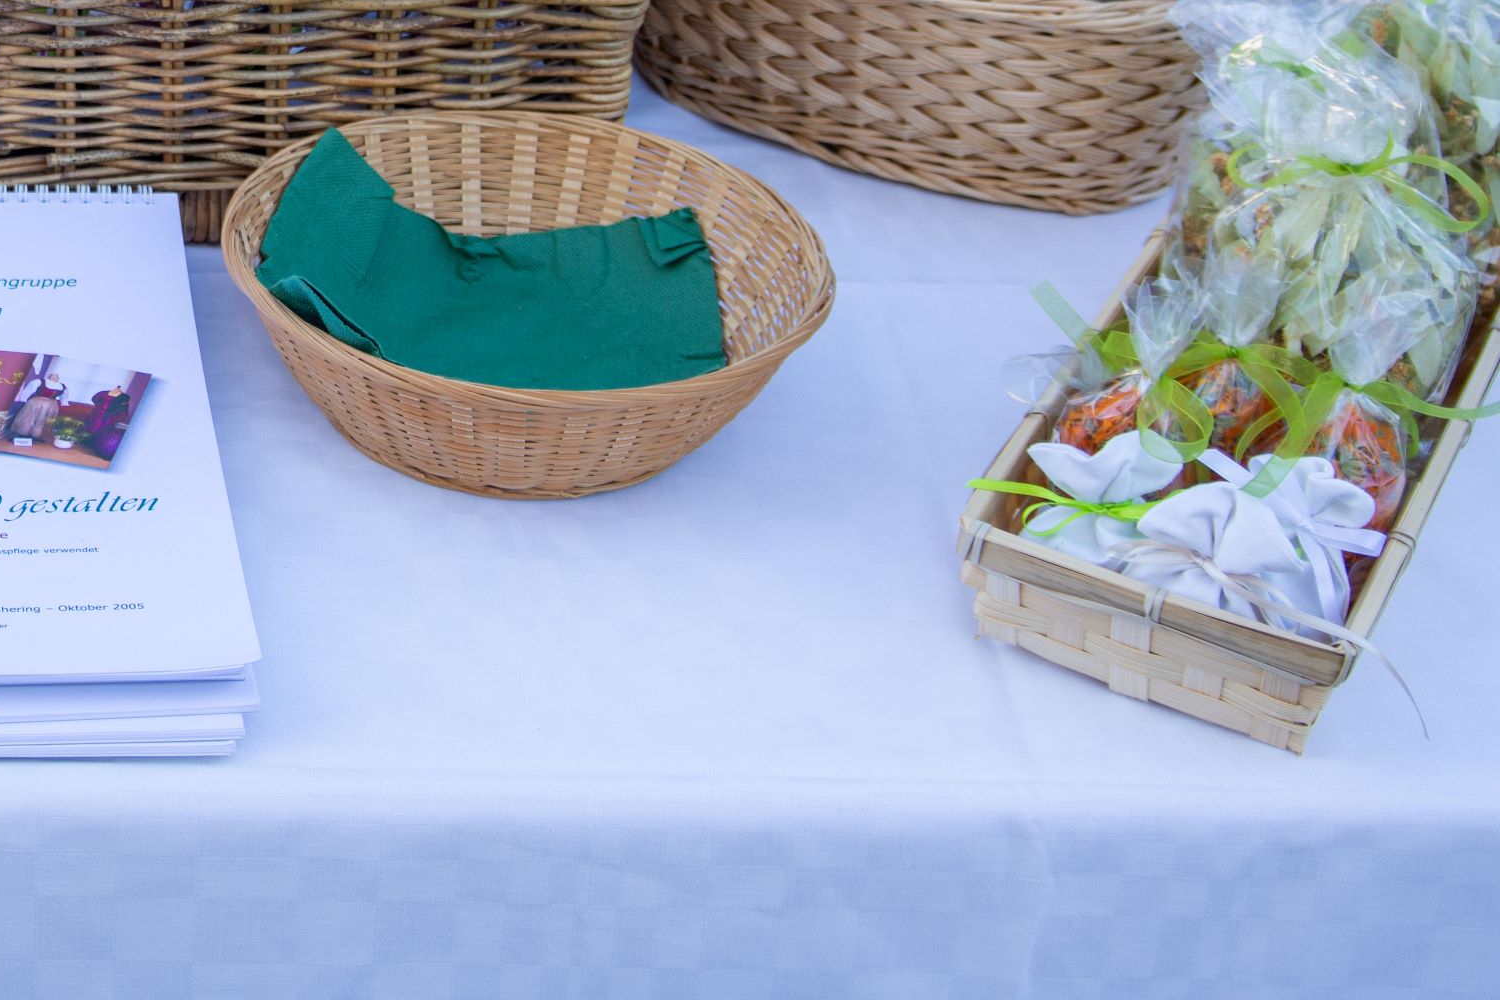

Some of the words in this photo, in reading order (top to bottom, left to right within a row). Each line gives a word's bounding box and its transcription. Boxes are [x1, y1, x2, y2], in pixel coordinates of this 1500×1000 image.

[3, 490, 159, 522] gestalten
[43, 546, 100, 554] verwendet
[57, 603, 108, 612] Oktober
[112, 602, 145, 611] 2005
